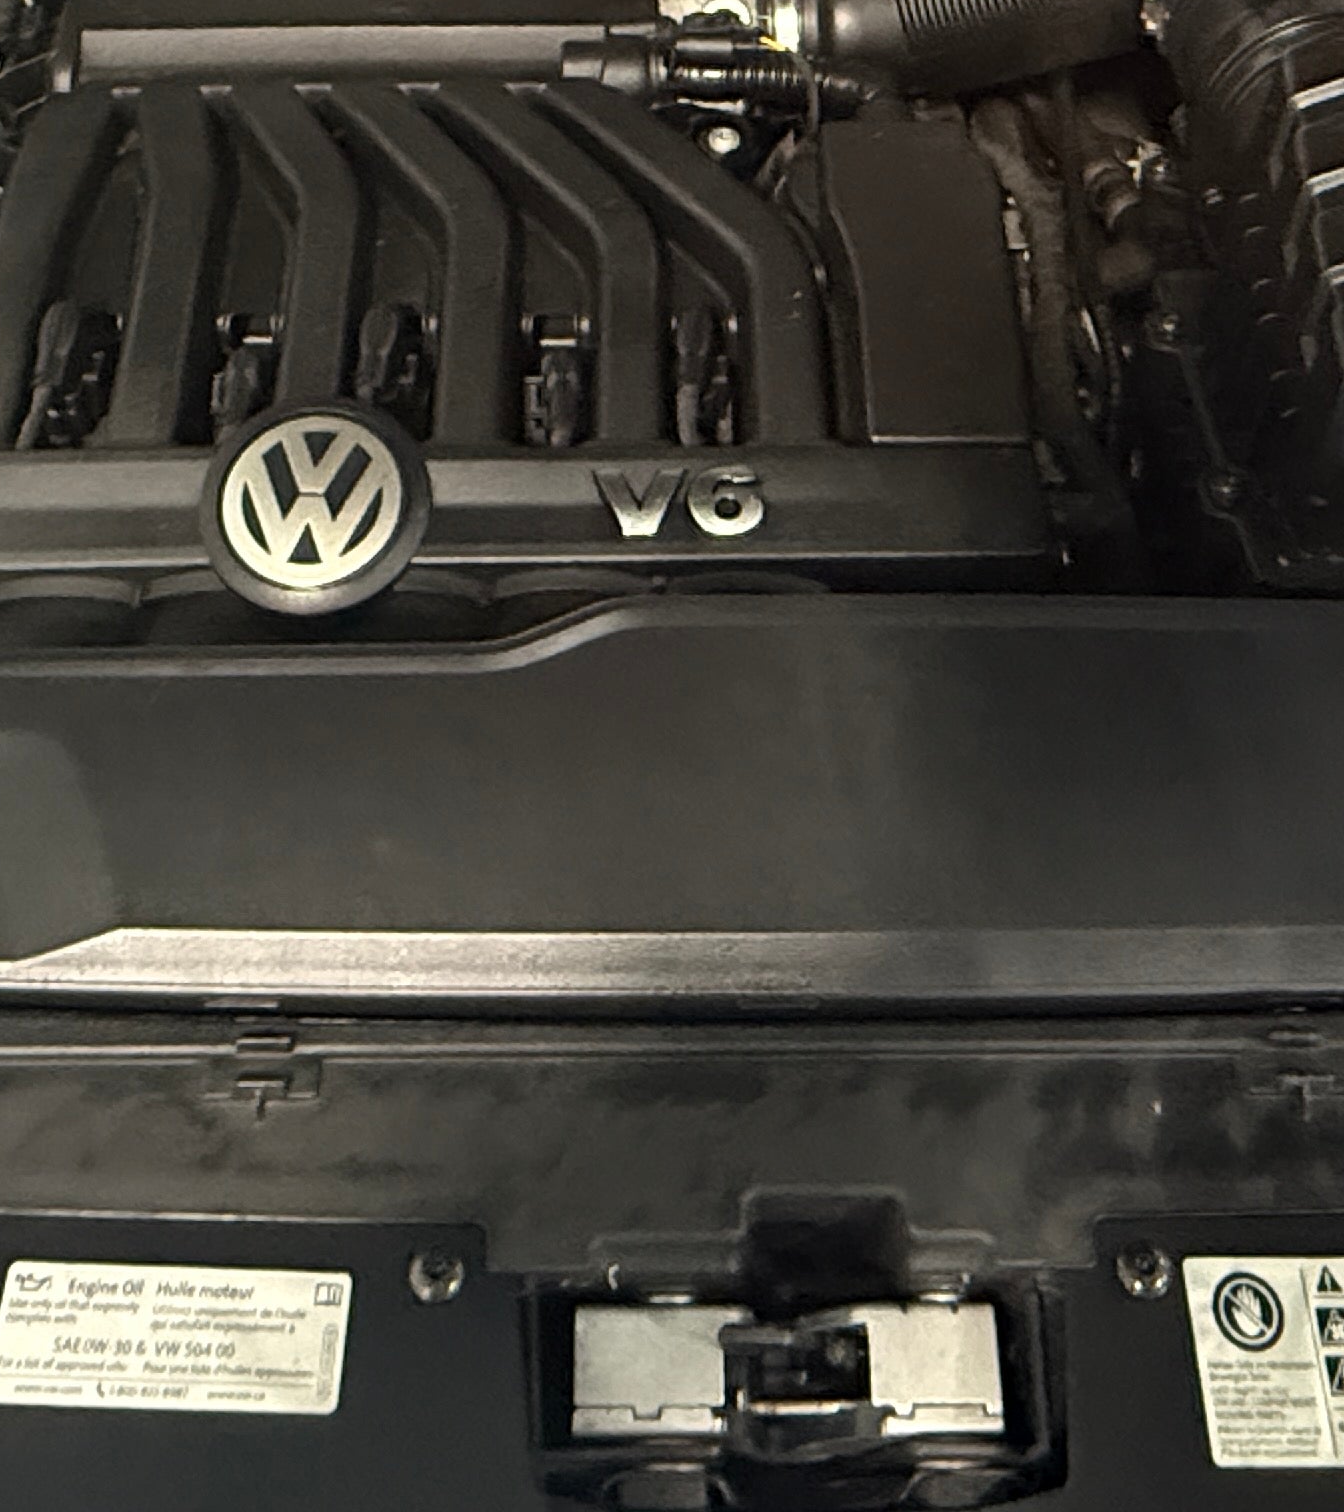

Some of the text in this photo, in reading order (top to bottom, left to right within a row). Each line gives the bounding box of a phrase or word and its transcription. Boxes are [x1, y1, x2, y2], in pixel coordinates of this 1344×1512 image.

[222, 415, 402, 589] VW
[592, 464, 767, 540] V6
[67, 1276, 146, 1299] Engine Oil
[156, 1279, 256, 1300] Huile moteur
